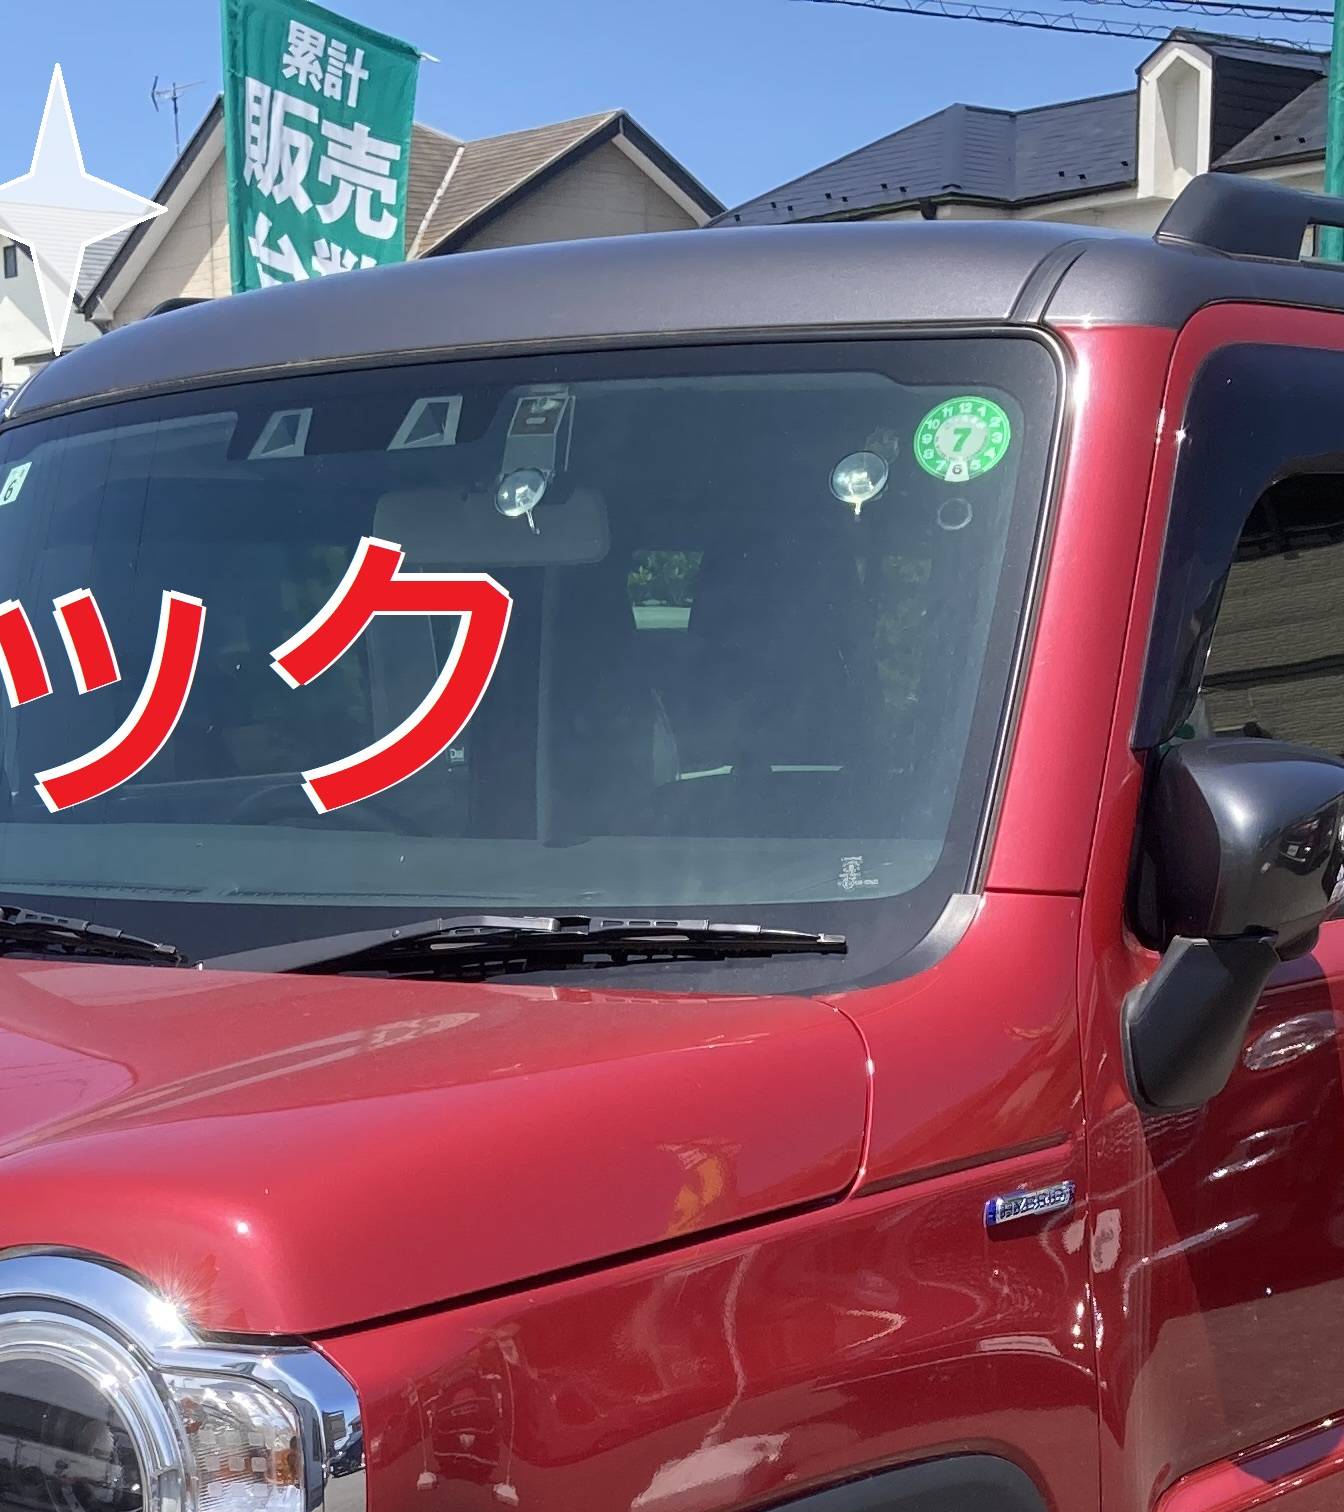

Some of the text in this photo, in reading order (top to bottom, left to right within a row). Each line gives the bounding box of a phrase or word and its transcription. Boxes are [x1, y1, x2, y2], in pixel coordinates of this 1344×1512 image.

[282, 20, 369, 107] 累計
[243, 76, 401, 240] 販売
[953, 427, 972, 452] 7
